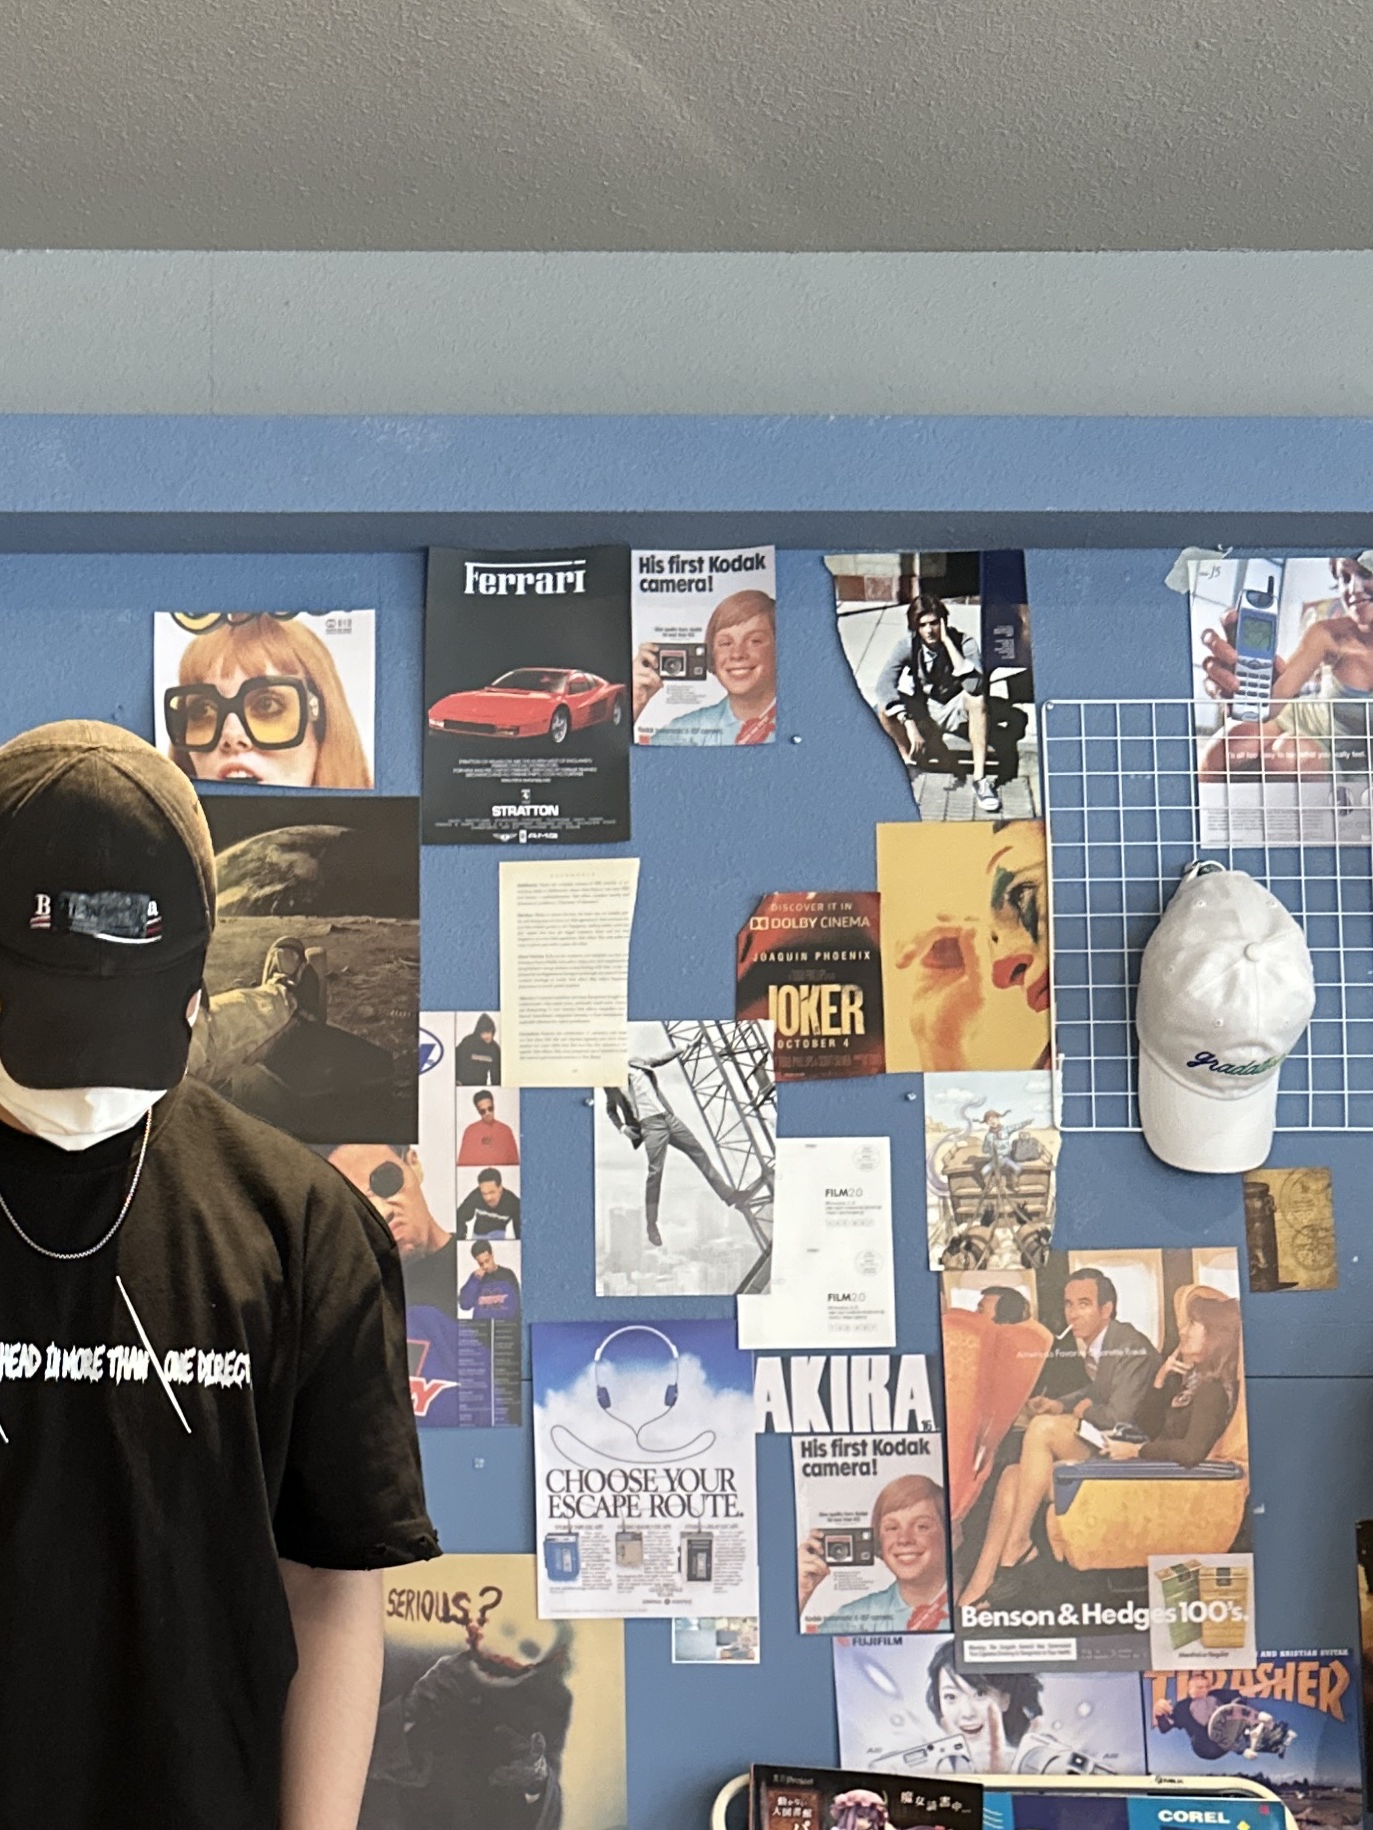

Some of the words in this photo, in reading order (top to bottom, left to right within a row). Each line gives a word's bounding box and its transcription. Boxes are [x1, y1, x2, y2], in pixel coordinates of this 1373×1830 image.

[639, 554, 664, 574] His
[668, 554, 704, 573] first
[709, 553, 766, 573] Kodak
[464, 560, 586, 595] Ferrari
[640, 576, 713, 593] camera!
[492, 805, 559, 817] STRATTON
[771, 903, 824, 911] DISCOVER
[828, 903, 836, 911] IT
[840, 902, 853, 911] IN
[771, 917, 818, 929] DOLBY
[820, 916, 870, 928] CINEMA
[753, 952, 808, 962] JOAQUIN
[815, 951, 871, 961] PHOENIX
[777, 1039, 836, 1048] OCTOBER
[843, 1038, 849, 1048] 4
[62, 1344, 106, 1383] MORE
[107, 1345, 149, 1386] THAN
[164, 1347, 196, 1385] ONE
[753, 1354, 936, 1433] AKIRA
[801, 1440, 827, 1458] His
[831, 1439, 868, 1457] first
[872, 1438, 930, 1456] Kodak
[802, 1458, 878, 1477] camera!
[546, 1468, 658, 1493] CHOOSE
[663, 1468, 737, 1493] YOUR
[548, 1494, 642, 1519] ESCAPE
[650, 1494, 744, 1518] ROUTE.
[961, 1605, 1054, 1627] Benson
[1057, 1603, 1080, 1627] &
[1082, 1600, 1176, 1631] Hedges
[1179, 1601, 1248, 1622] 100's.
[852, 1636, 903, 1646] FUJIFILM
[1158, 1809, 1230, 1824] COREL
